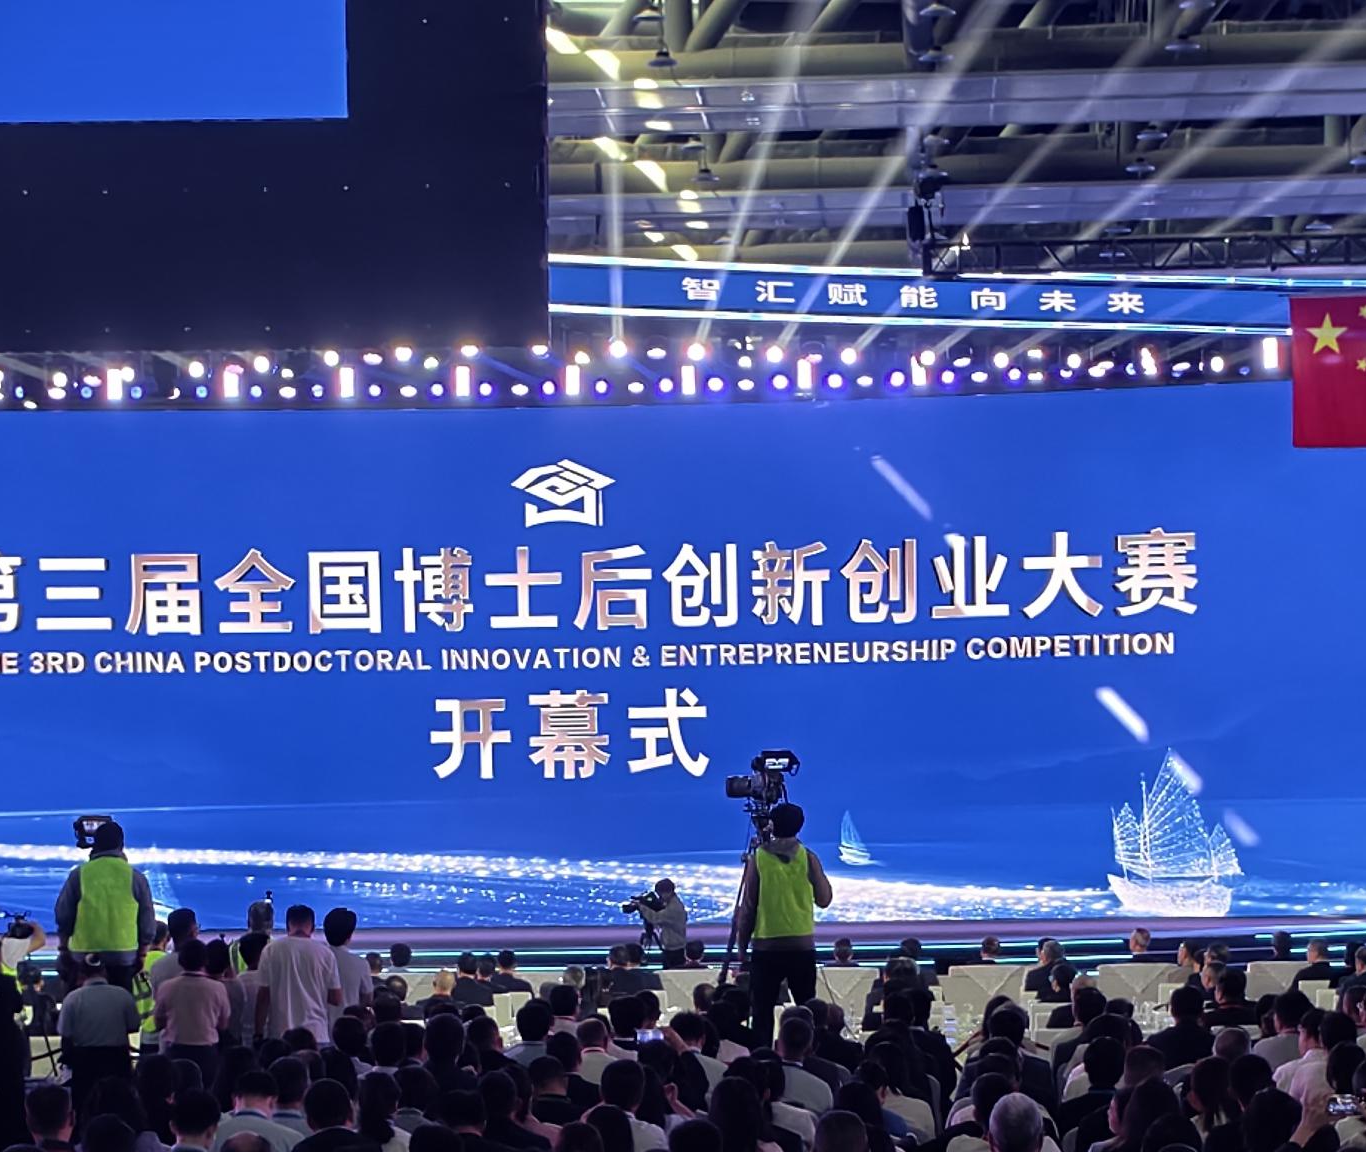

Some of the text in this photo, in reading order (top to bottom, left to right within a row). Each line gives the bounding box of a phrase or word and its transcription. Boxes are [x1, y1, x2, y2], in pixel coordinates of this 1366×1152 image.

[681, 276, 1145, 314] 智汇赋能向未来
[29, 652, 85, 674] 3RD
[94, 651, 185, 674] CHINA
[194, 648, 433, 673] POSTDOCTORAL
[441, 646, 621, 671] INNOVATION
[631, 646, 651, 668] &
[660, 639, 957, 667] ENTREPRENEURSHIP
[966, 632, 1175, 660] COMPETITION
[430, 687, 710, 780] 开幕式
